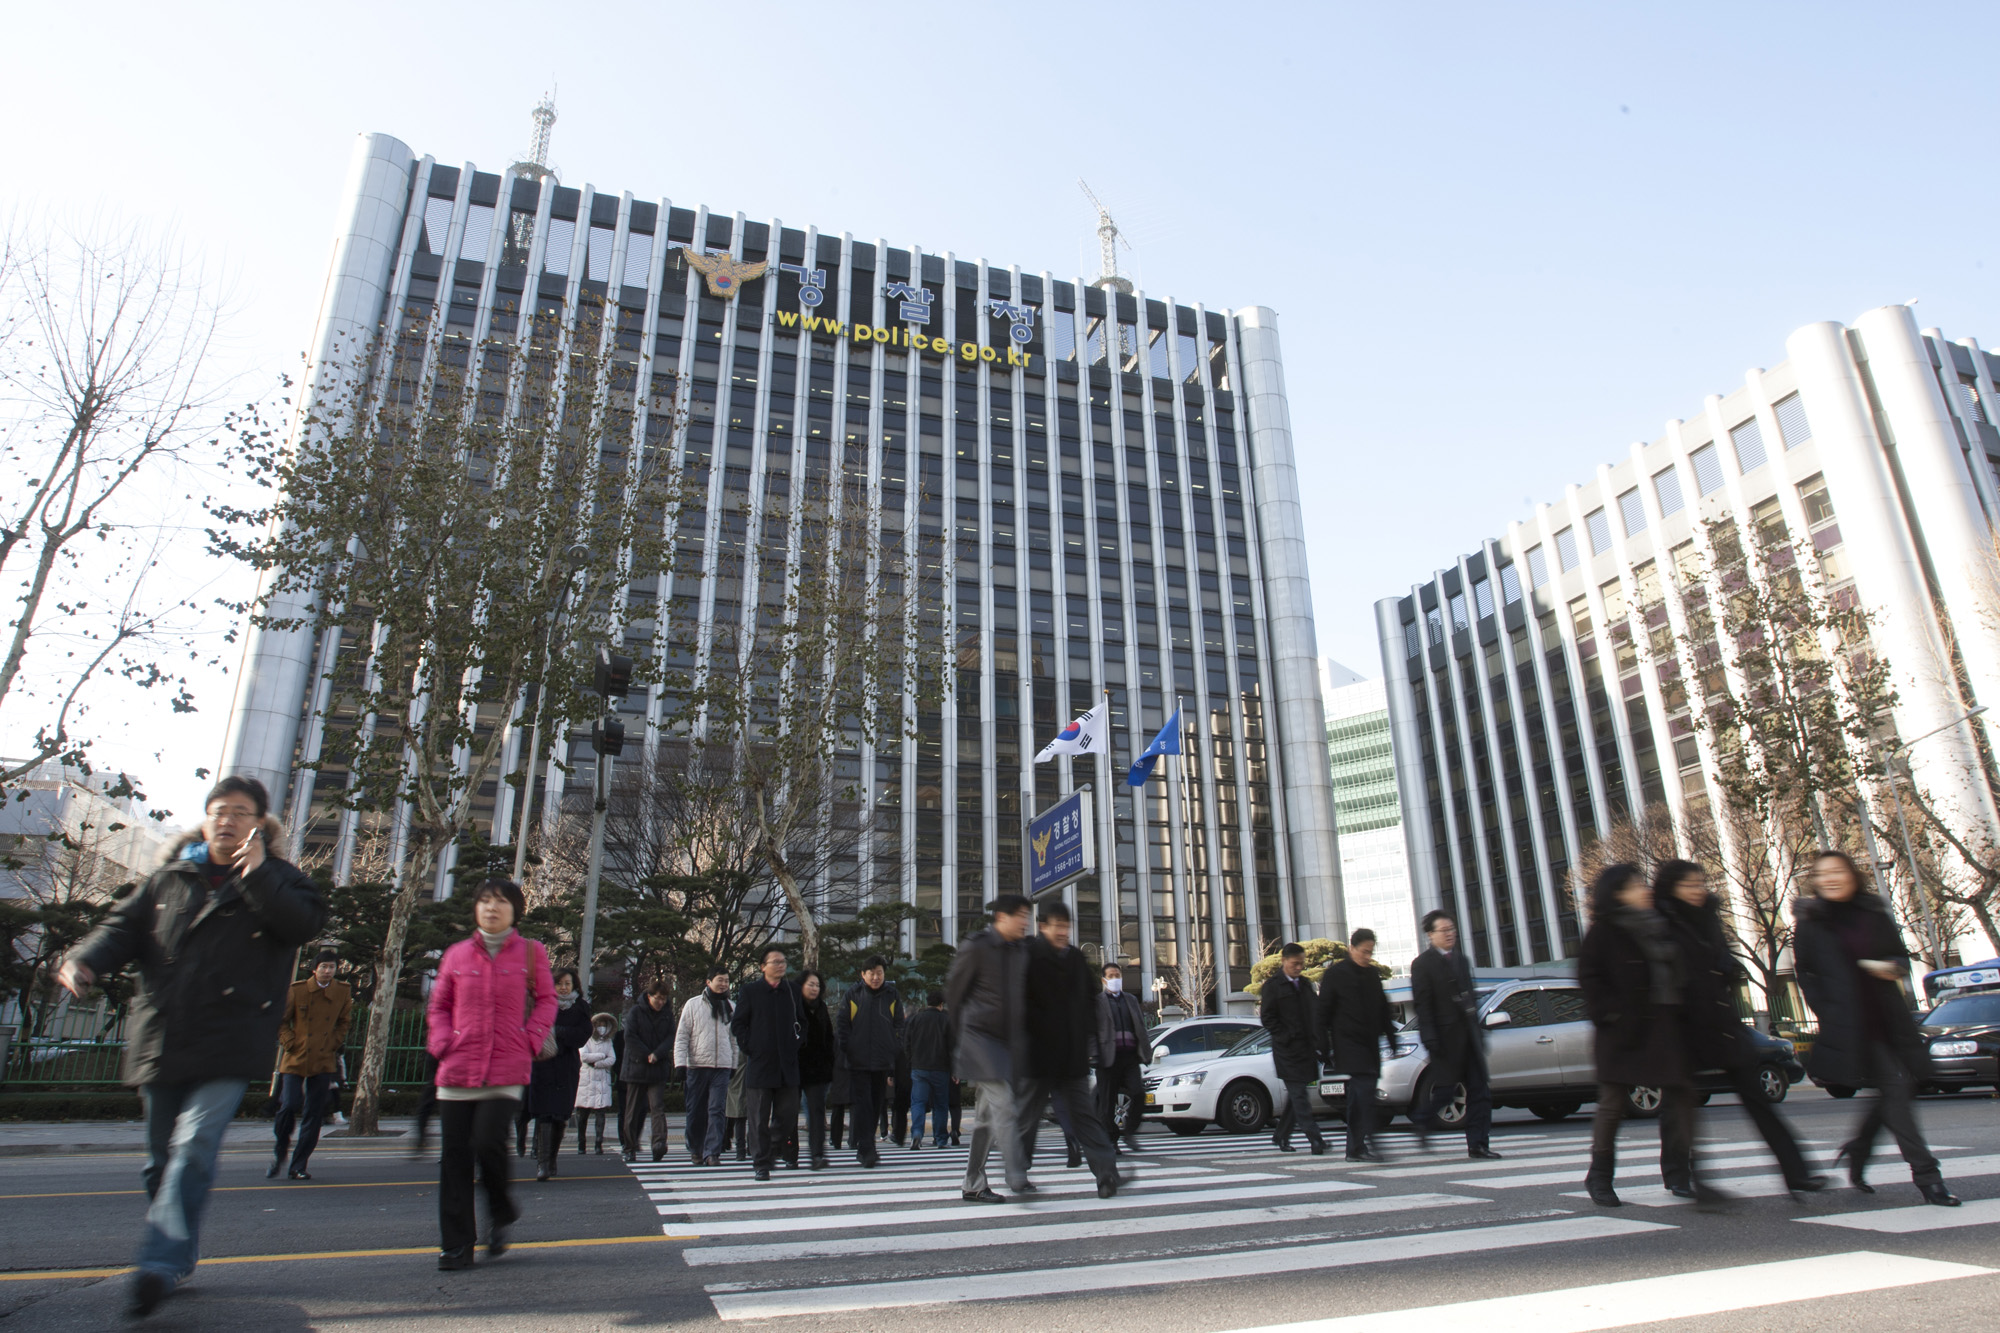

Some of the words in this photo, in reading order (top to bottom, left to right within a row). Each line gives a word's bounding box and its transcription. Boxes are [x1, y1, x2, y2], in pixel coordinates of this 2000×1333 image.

[780, 263, 1035, 343] 경찰청
[777, 310, 1032, 367] www.police.go.kr
[1053, 809, 1079, 840] 경찰청
[1054, 853, 1081, 874] 1566-0112
